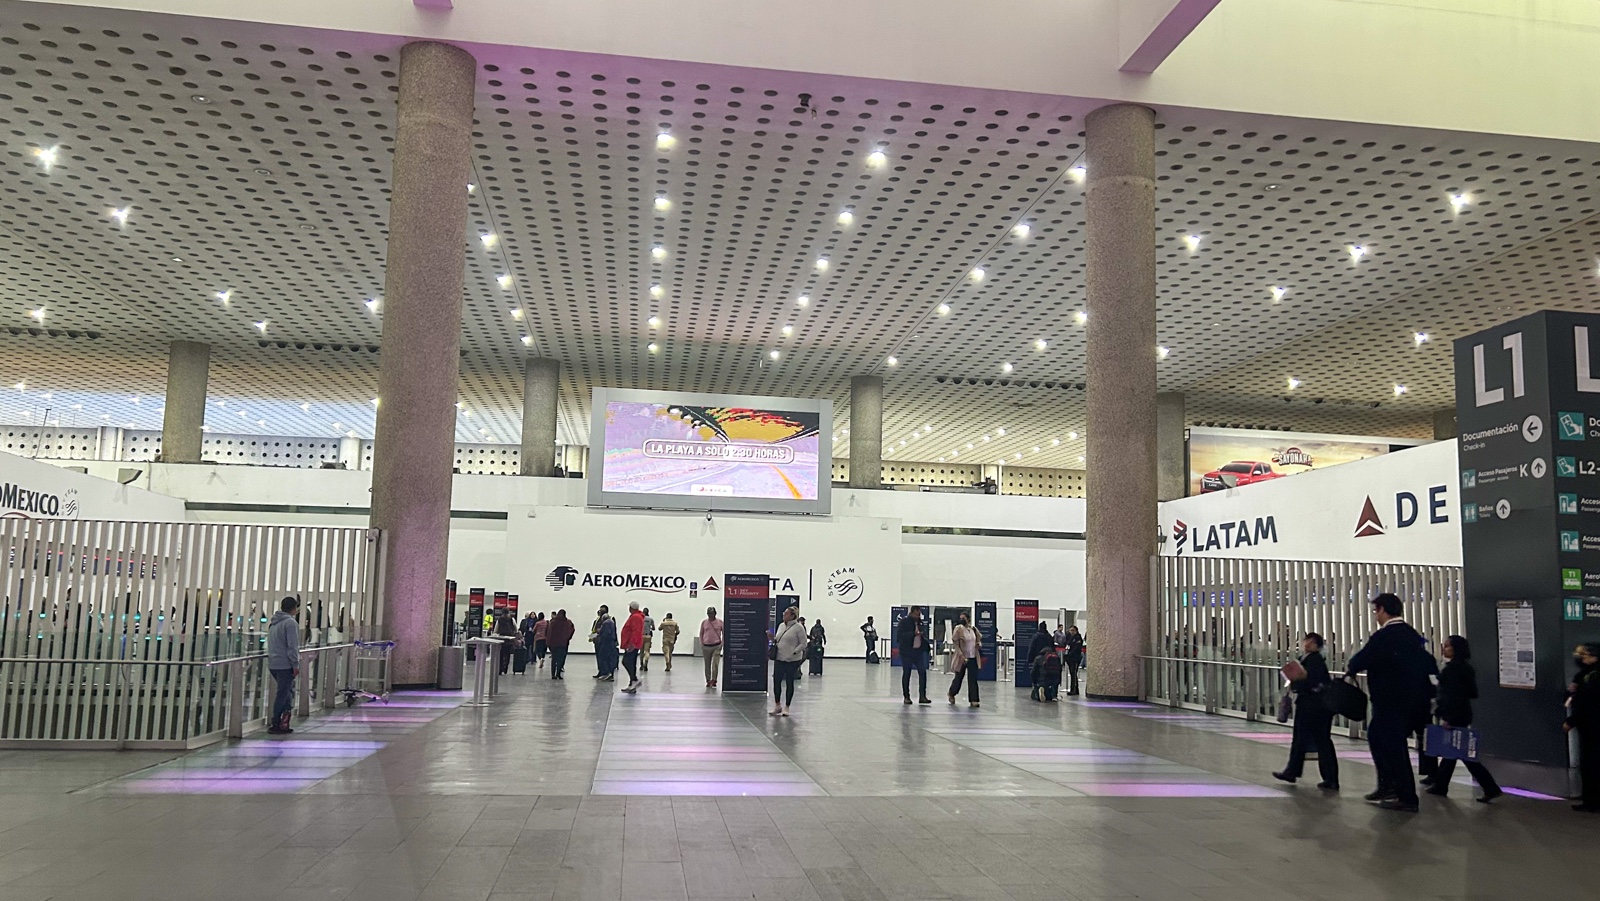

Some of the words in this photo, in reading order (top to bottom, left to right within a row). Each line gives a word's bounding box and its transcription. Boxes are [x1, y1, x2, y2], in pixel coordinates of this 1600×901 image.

[1574, 325, 1600, 393] L
[1473, 331, 1525, 408] L1
[1588, 417, 1600, 427] Do
[1462, 423, 1519, 442] Documentación
[651, 444, 663, 453] LA
[665, 444, 695, 455] PLAYA
[696, 446, 703, 456] A
[732, 448, 752, 458] 2:30
[754, 449, 786, 459] HORAS
[1463, 442, 1486, 451] Check-in
[1278, 453, 1314, 466] SAYONARA
[1519, 463, 1528, 477] K
[1578, 460, 1600, 475] L2-
[0, 482, 59, 516] MEXICO.
[1395, 485, 1449, 528] DE
[1192, 515, 1278, 552] LATAM
[827, 567, 855, 597] SKYTEAM
[1584, 572, 1600, 580] Aero
[769, 578, 795, 591] TA
[1585, 603, 1600, 611] Baño
